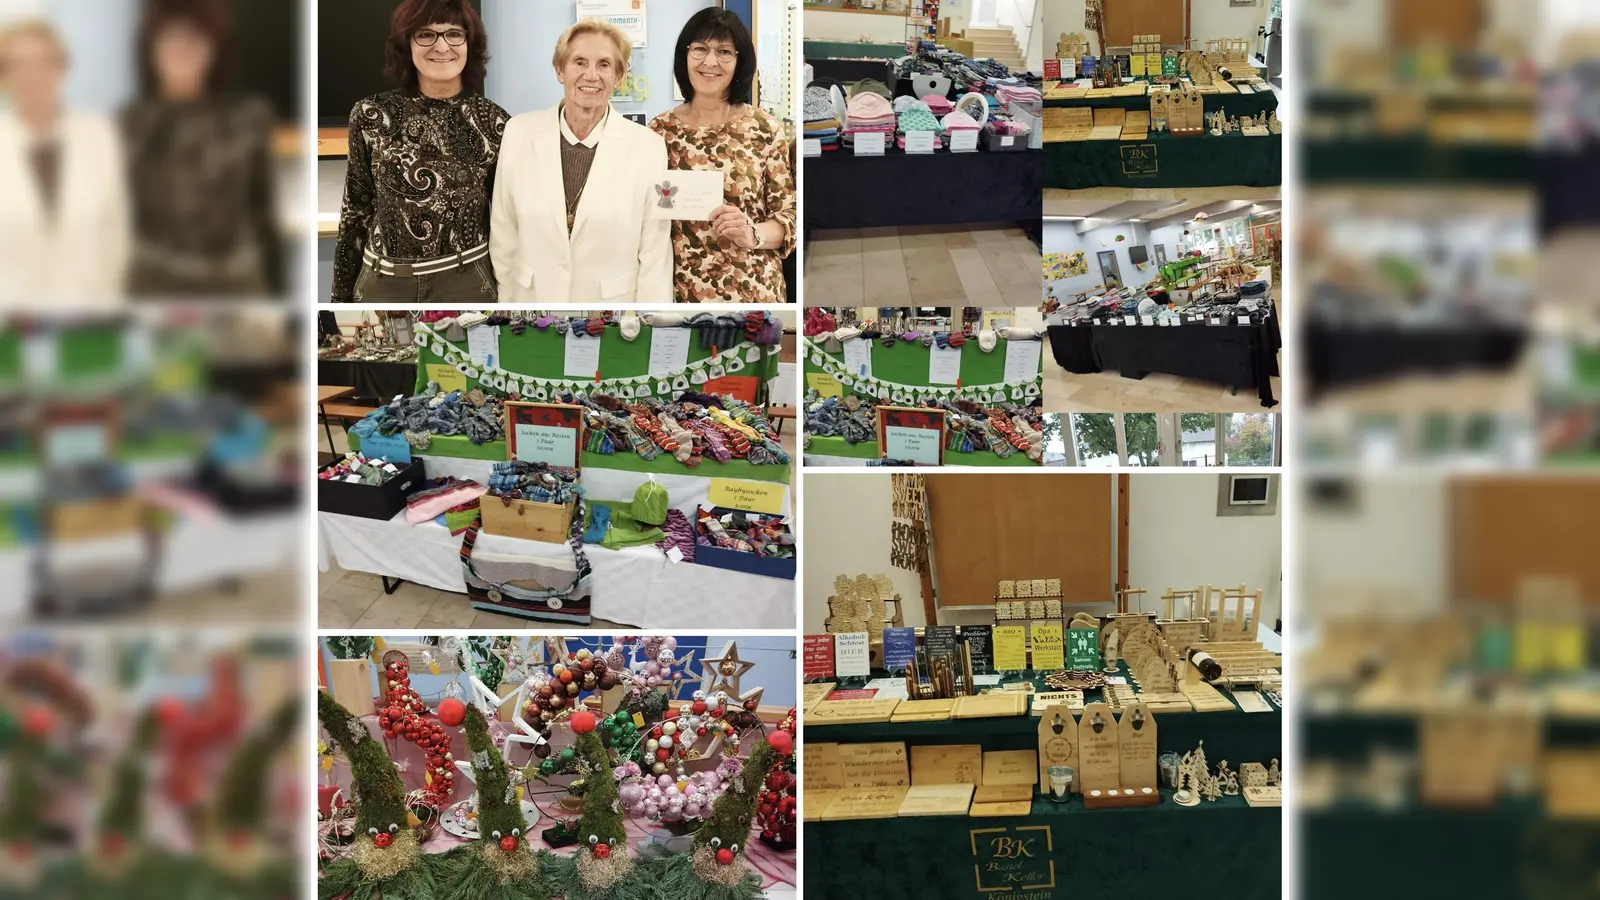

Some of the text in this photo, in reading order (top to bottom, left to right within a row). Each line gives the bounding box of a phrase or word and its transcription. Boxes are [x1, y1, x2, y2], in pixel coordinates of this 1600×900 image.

[520, 429, 540, 437] Socken
[840, 648, 864, 656] BIER
[869, 748, 891, 756] größte
[843, 760, 871, 768] Wunder
[991, 836, 1035, 859] BK
[985, 861, 1023, 872] Bastel
[1002, 871, 1044, 883] Keller
[987, 890, 1052, 900] Königstein
